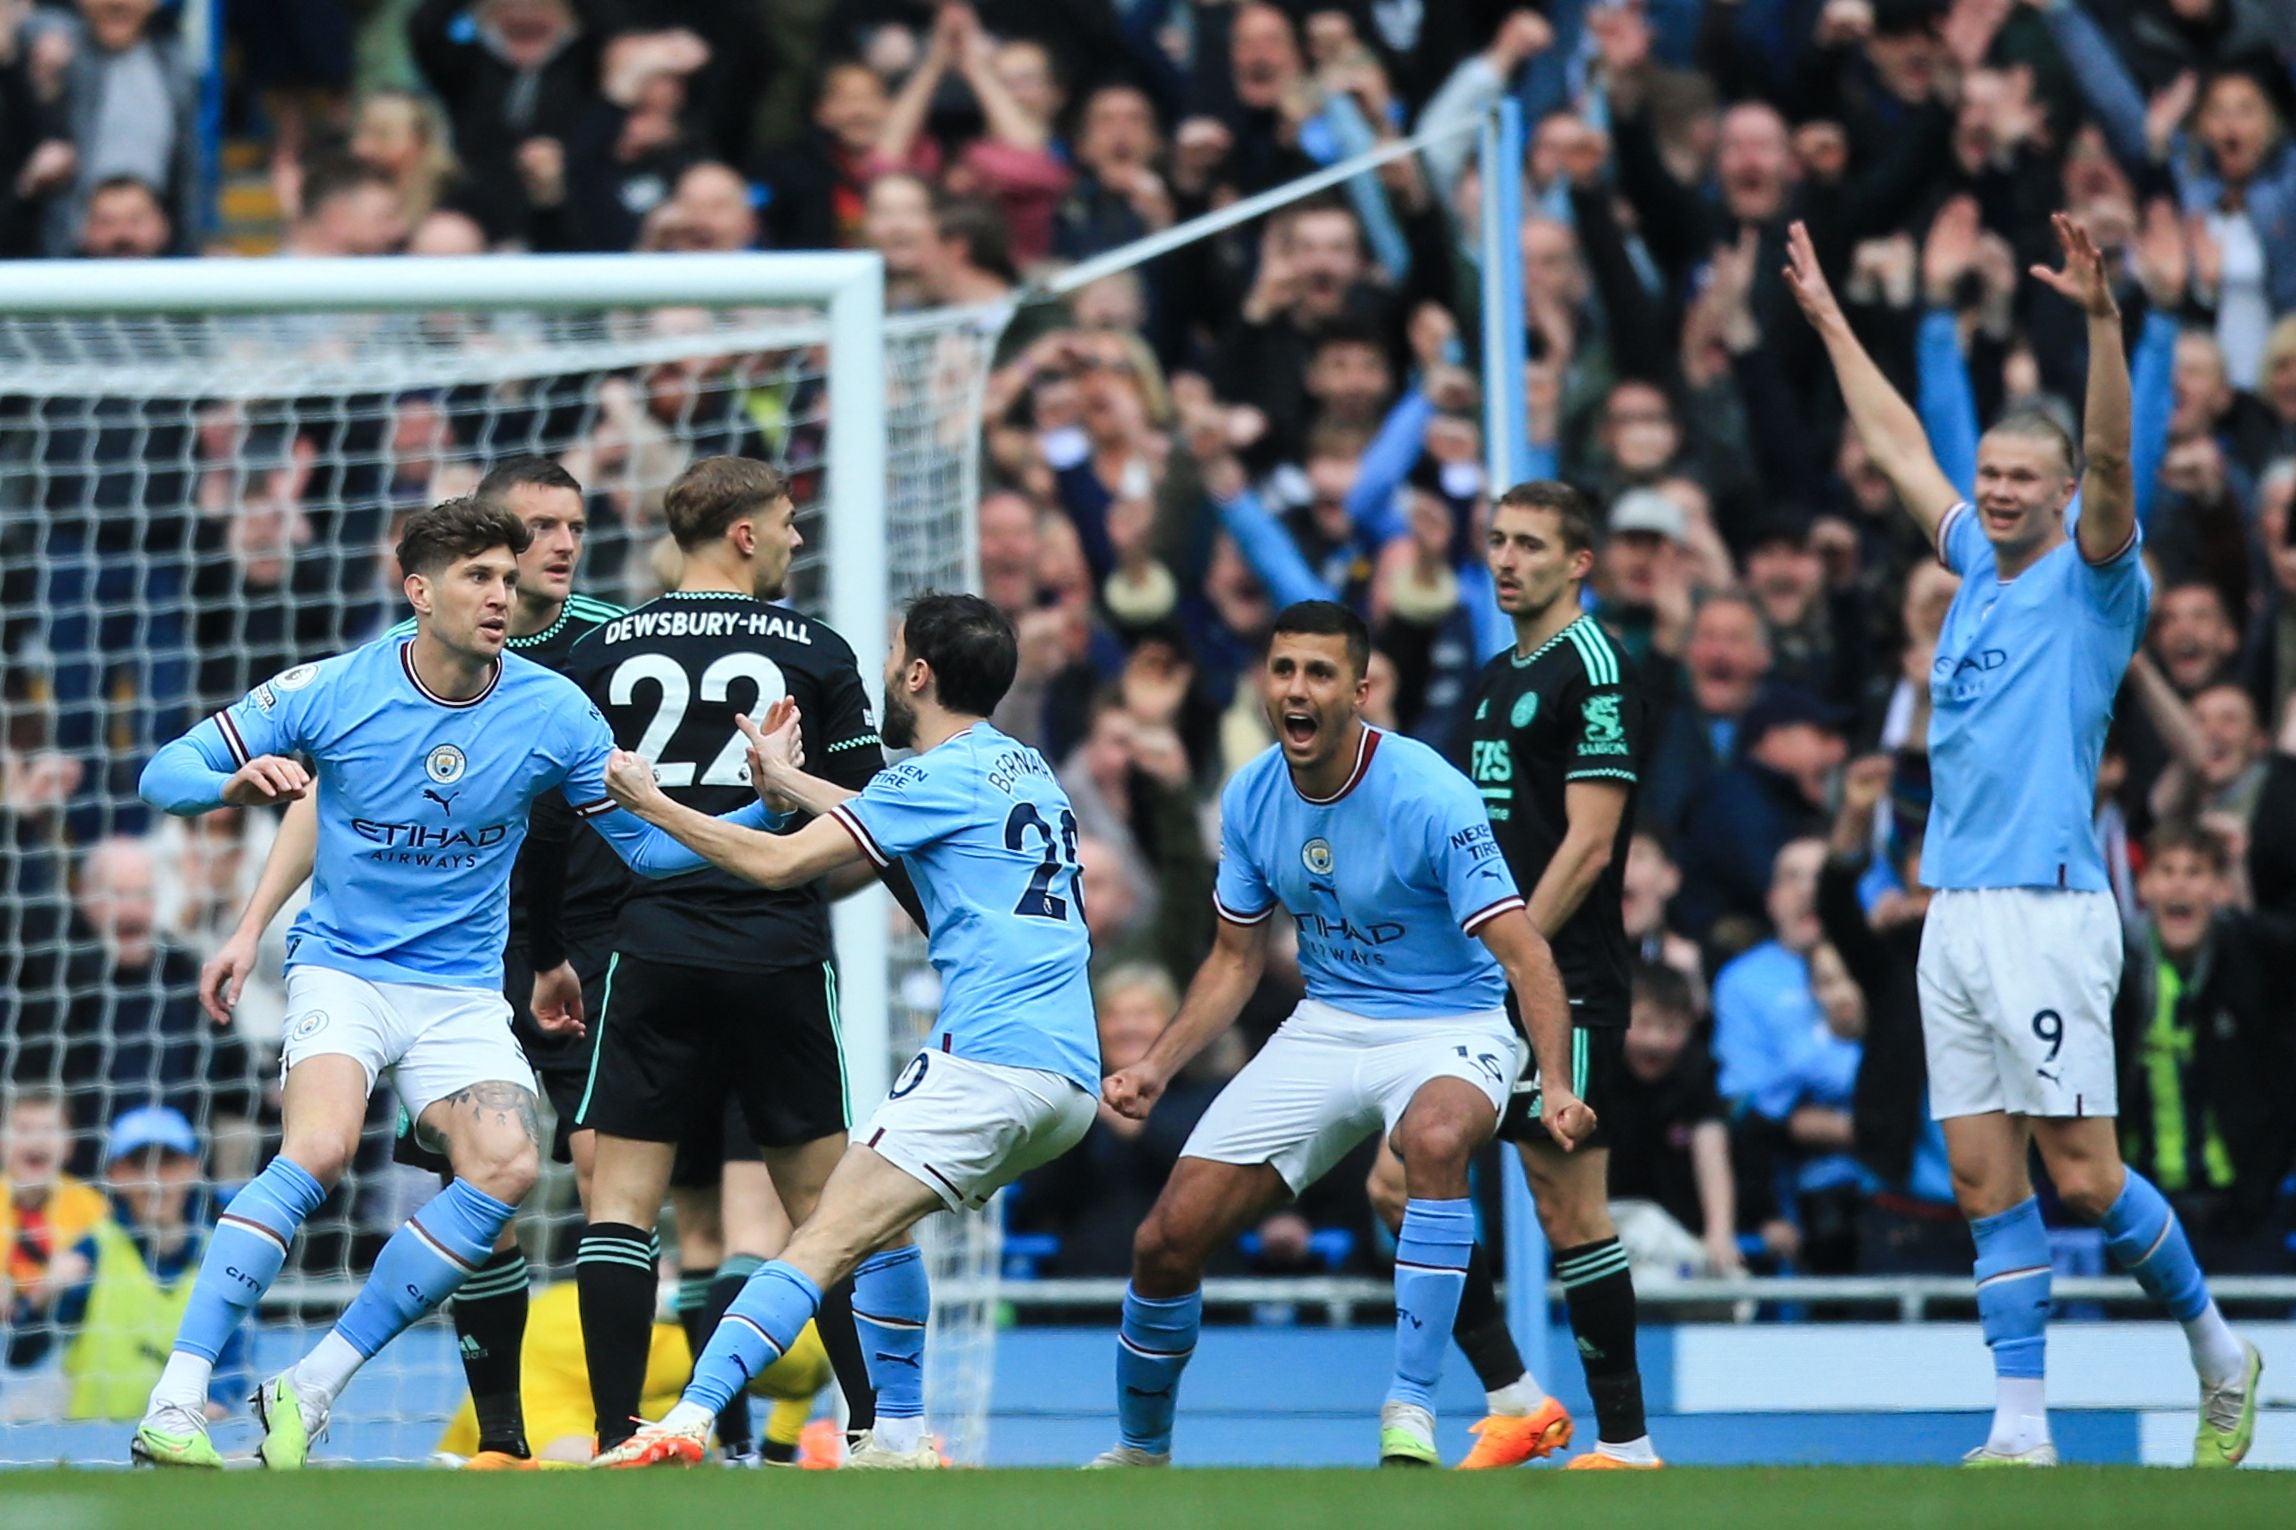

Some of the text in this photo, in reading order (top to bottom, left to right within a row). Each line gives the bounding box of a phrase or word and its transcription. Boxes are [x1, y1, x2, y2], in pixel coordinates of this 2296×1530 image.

[605, 612, 812, 645] DEWSBURY-HALL
[609, 652, 787, 787] 22
[351, 817, 507, 850] ETIHAD
[371, 851, 476, 869] AIRWAYS
[1292, 912, 1406, 946] TIHAD
[2032, 1008, 2064, 1062] 9
[225, 1266, 262, 1293] CITY
